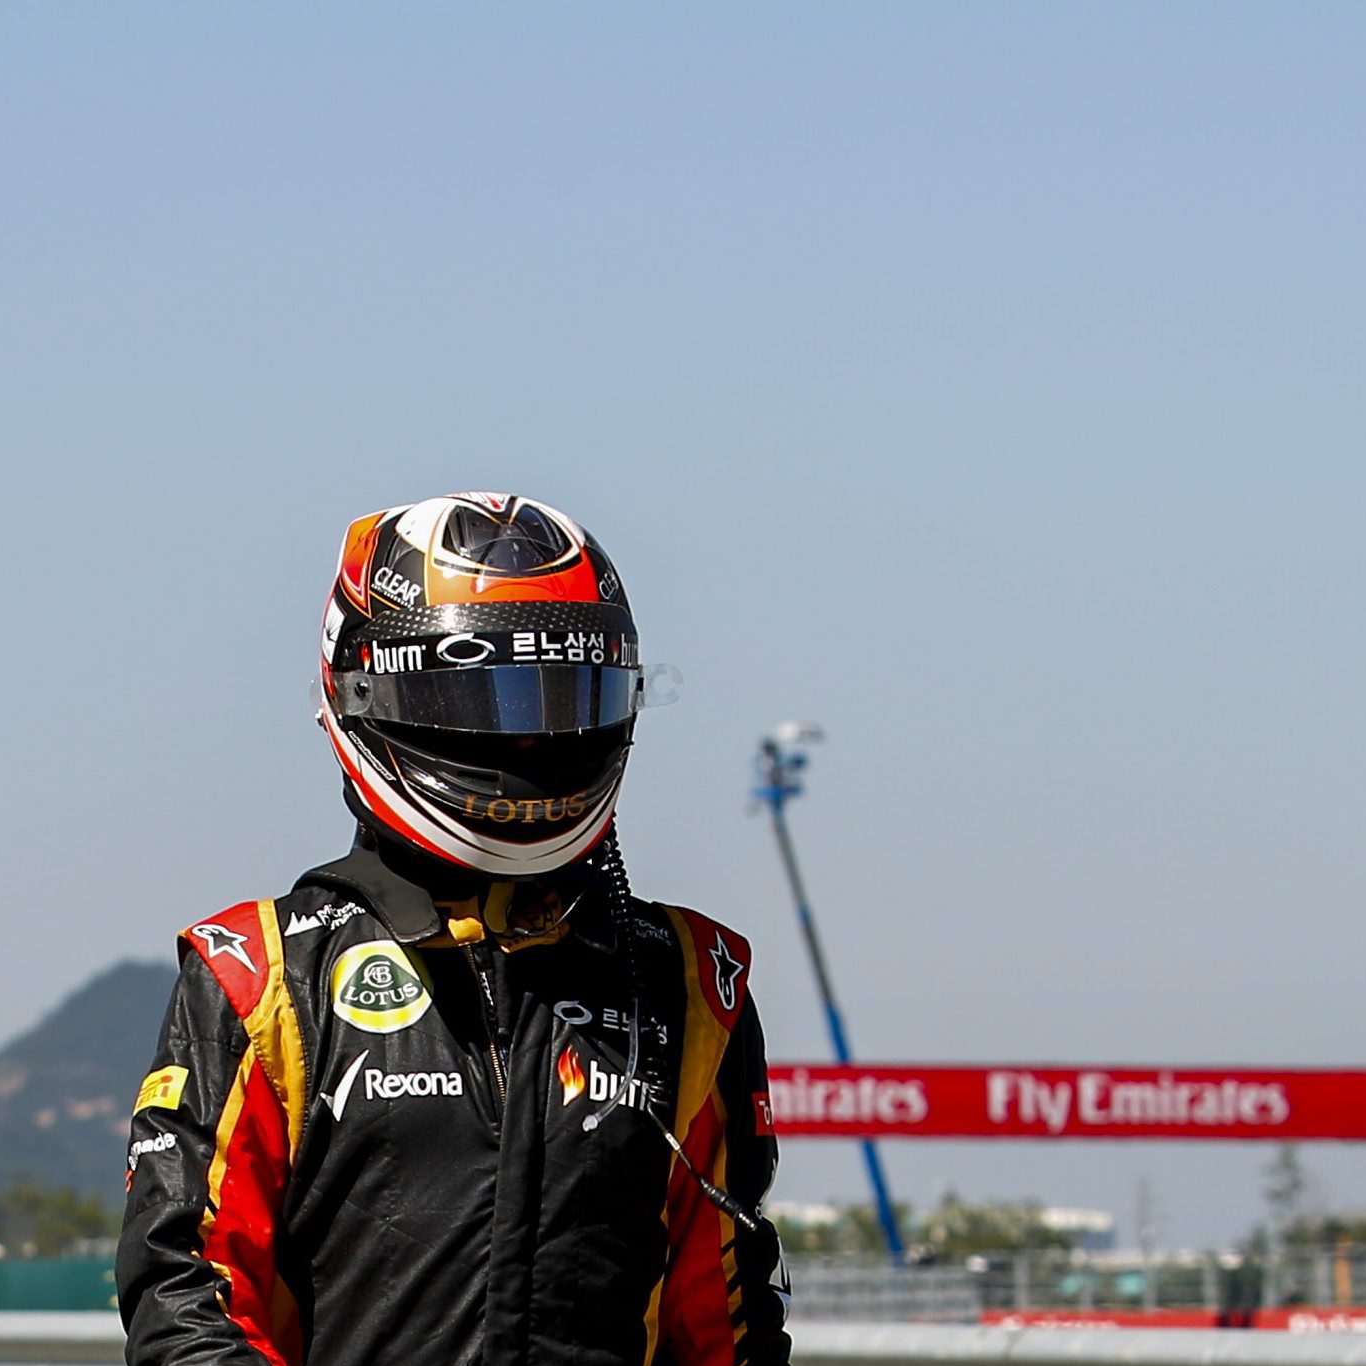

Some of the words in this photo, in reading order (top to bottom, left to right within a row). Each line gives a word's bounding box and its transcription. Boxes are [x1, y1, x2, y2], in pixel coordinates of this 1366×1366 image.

[374, 566, 421, 606] CLEAR
[372, 639, 422, 674] burn
[512, 631, 605, 664] 르노삼성
[461, 792, 588, 824] LOTUS
[344, 982, 419, 1006] LOTUS
[365, 1068, 463, 1101] Rexona
[770, 1067, 928, 1125] mirates
[1076, 1068, 1291, 1126] Emirates
